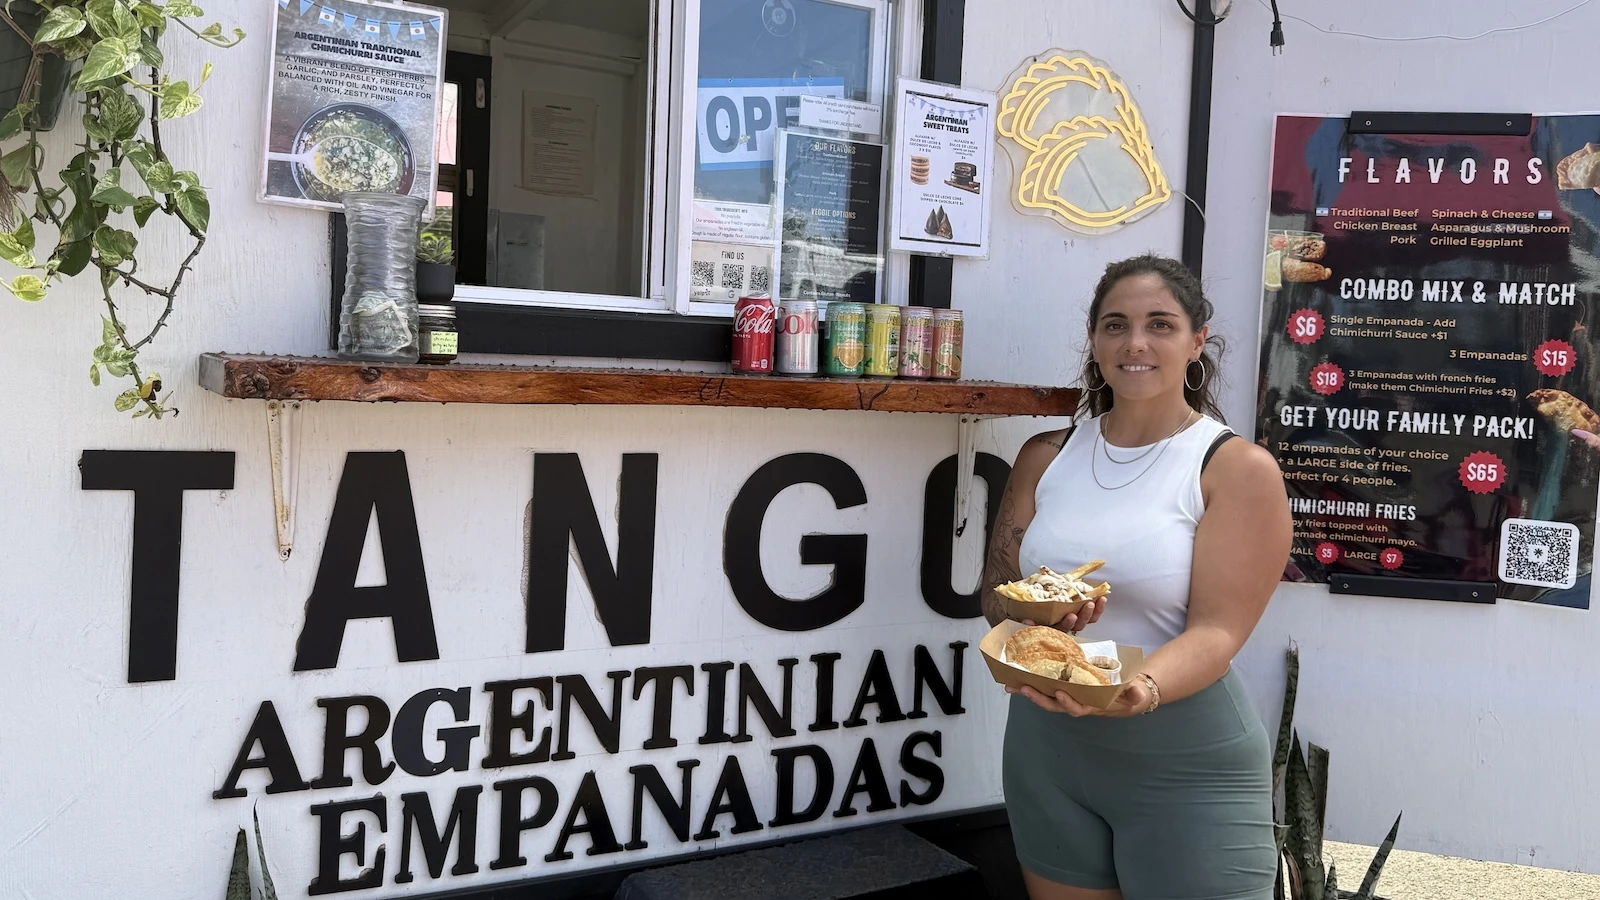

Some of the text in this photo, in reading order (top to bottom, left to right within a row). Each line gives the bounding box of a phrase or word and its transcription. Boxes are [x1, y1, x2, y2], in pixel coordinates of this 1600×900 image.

[294, 31, 422, 58] ARGENTINIAN TRADITIONAL
[311, 43, 404, 64] CHIMICHURRI SAUCE
[286, 64, 425, 90] GARLIC, AND PARSLEY, PERFECTLY
[292, 56, 328, 68] VIBRANT
[330, 62, 356, 71] BLEND
[372, 68, 396, 78] FRESH
[398, 72, 427, 84] HERBS,
[278, 71, 322, 83] BALANCED
[324, 78, 344, 86] WITH
[362, 84, 378, 92] AND
[380, 86, 414, 98] VINEGAR
[416, 91, 432, 100] FOR
[321, 86, 342, 96] RICH,
[344, 89, 369, 98] ZESTY
[371, 93, 398, 102] FINISH.
[706, 95, 800, 153] OPE
[923, 122, 969, 134] SWEET TREATS
[926, 114, 968, 126] ARGENTINIAN
[814, 142, 856, 154] OUR FLAVORS
[1338, 157, 1542, 184] FLAVORS
[811, 208, 856, 219] VEGGIE OPTIONS
[1330, 207, 1419, 218] Traditional Beef
[1432, 208, 1535, 221] Spinach & Cheese
[1334, 221, 1418, 231] Chicken Breast
[1430, 223, 1570, 235] Asparagus & Mushroom
[1390, 235, 1416, 244] Pork
[1430, 236, 1524, 249] Grilled Eggplant
[1340, 278, 1576, 306] COMBO MIX & MATCH
[777, 306, 818, 334] Cok
[1295, 316, 1317, 337] $6
[1330, 315, 1364, 326] Single
[1366, 316, 1425, 328] Empanada
[1434, 318, 1456, 328] Add
[1330, 328, 1448, 340] Chimichurri Sauce +$1
[1450, 350, 1528, 362] 3 Empanadas
[1542, 350, 1568, 367] $15
[1316, 370, 1338, 386] $18
[1349, 370, 1496, 384] 3 Empanadas with french fries
[1348, 381, 1517, 398] (make them Chimichurri Fries +$2)
[1280, 405, 1535, 440] GET YOUR FAMILY PACK!
[1278, 442, 1449, 460] 12 empanadas of your choice
[1297, 458, 1336, 468] LARGE
[1340, 459, 1364, 470] side
[1366, 460, 1379, 470] of
[1381, 462, 1412, 473] fries.
[1466, 464, 1498, 482] $65
[1322, 472, 1338, 482] for
[1342, 474, 1350, 484] 4
[1353, 475, 1396, 488] people.
[1376, 503, 1416, 520] FRIES
[1306, 519, 1326, 528] fries
[1329, 520, 1364, 531] topped
[1366, 524, 1388, 532] with
[1293, 531, 1418, 547] emade chimichurri mayo.
[1322, 548, 1332, 558] $5
[1344, 550, 1377, 560] LARGE
[1386, 554, 1397, 564] $7
[80, 450, 1011, 683] TANGO
[213, 641, 969, 799] ARGENTINIAN
[309, 731, 945, 896] EMPANADAS
